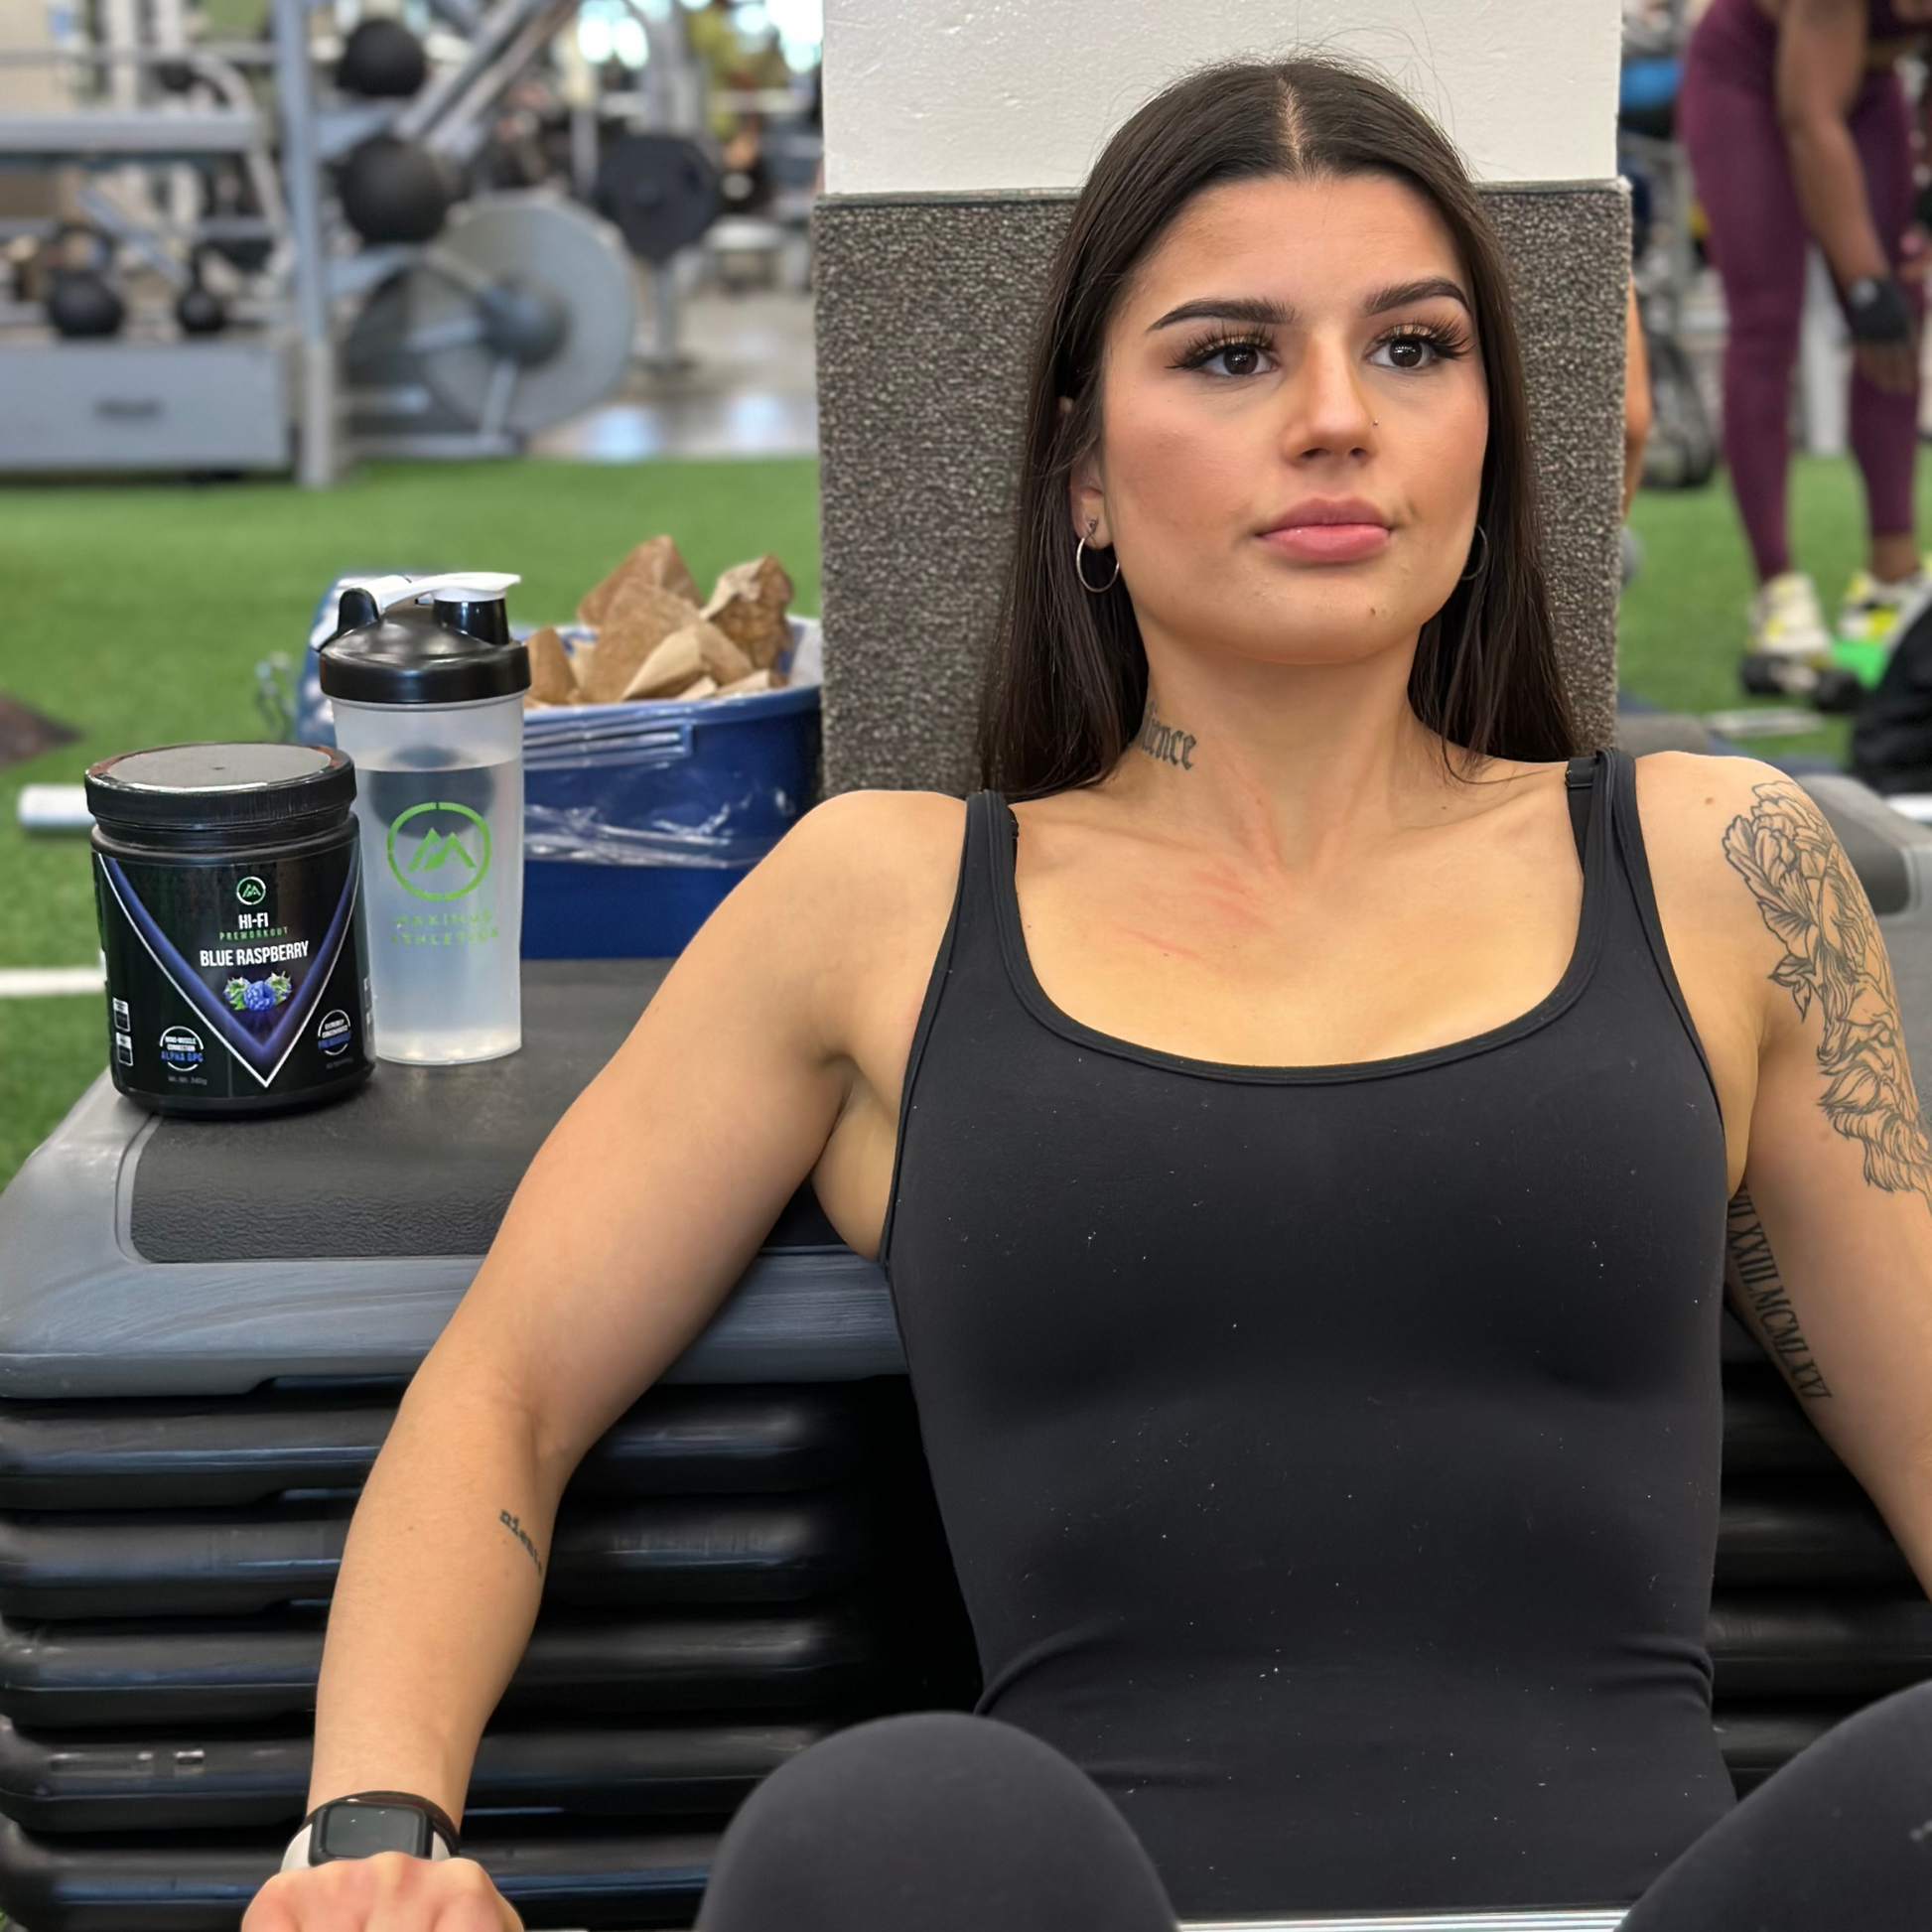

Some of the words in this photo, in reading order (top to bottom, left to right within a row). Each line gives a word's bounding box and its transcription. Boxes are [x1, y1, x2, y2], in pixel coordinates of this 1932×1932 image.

[238, 912, 269, 929] HI-FI
[218, 925, 288, 941] PREWORKOUT
[200, 949, 234, 967] BLUE
[236, 940, 310, 966] RASPBERRY
